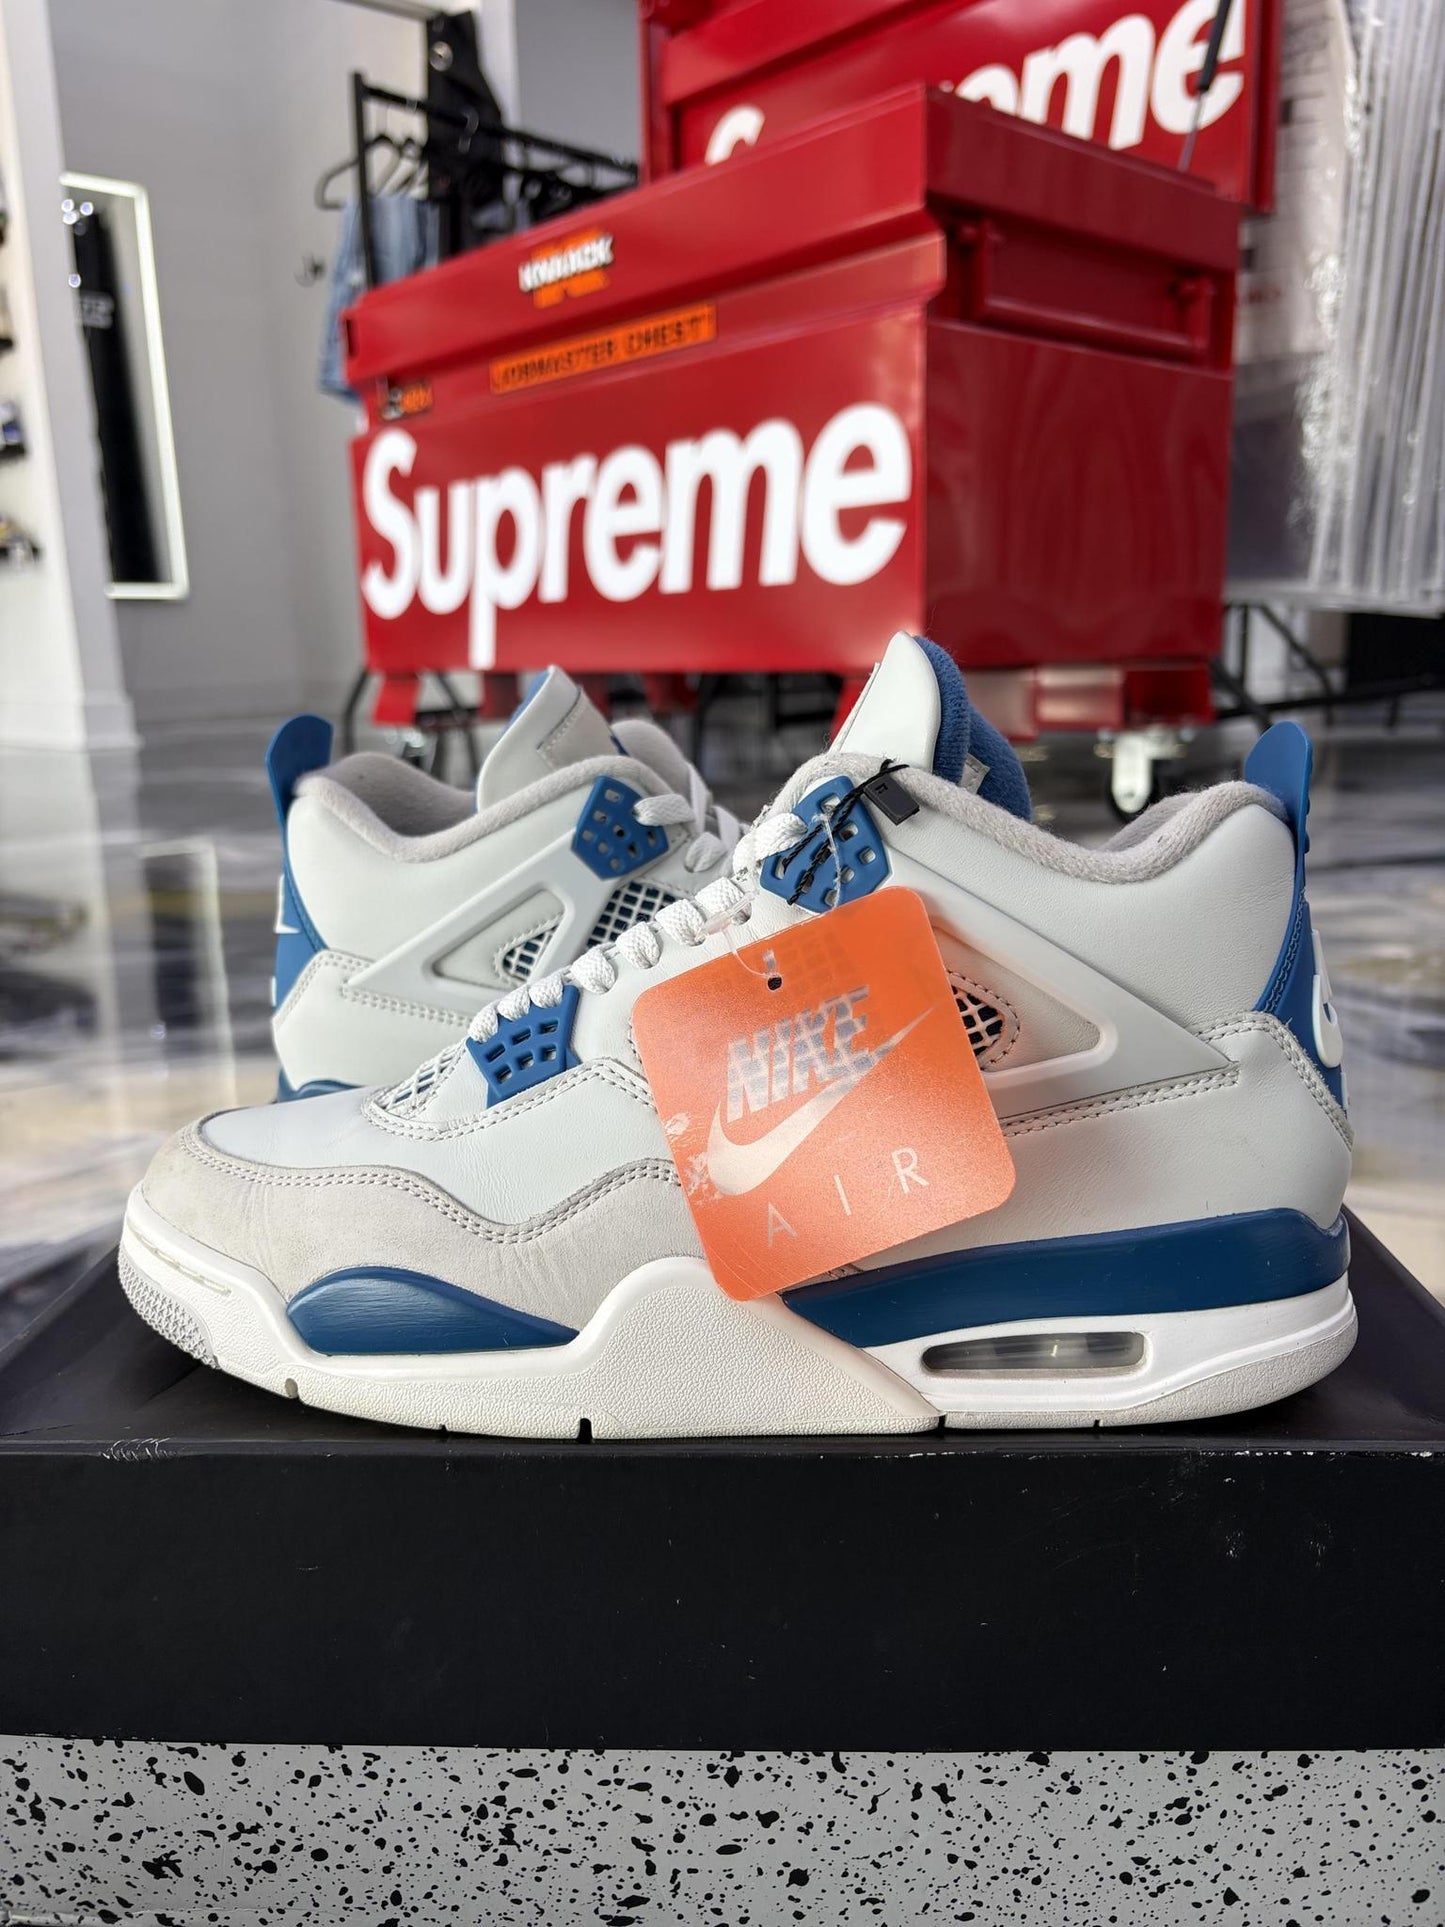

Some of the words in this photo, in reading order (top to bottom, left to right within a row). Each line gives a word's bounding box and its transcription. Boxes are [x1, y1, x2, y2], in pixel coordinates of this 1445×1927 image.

[361, 403, 911, 669] Supreme
[726, 985, 869, 1123] NIKE
[766, 1146, 930, 1248] AIR
